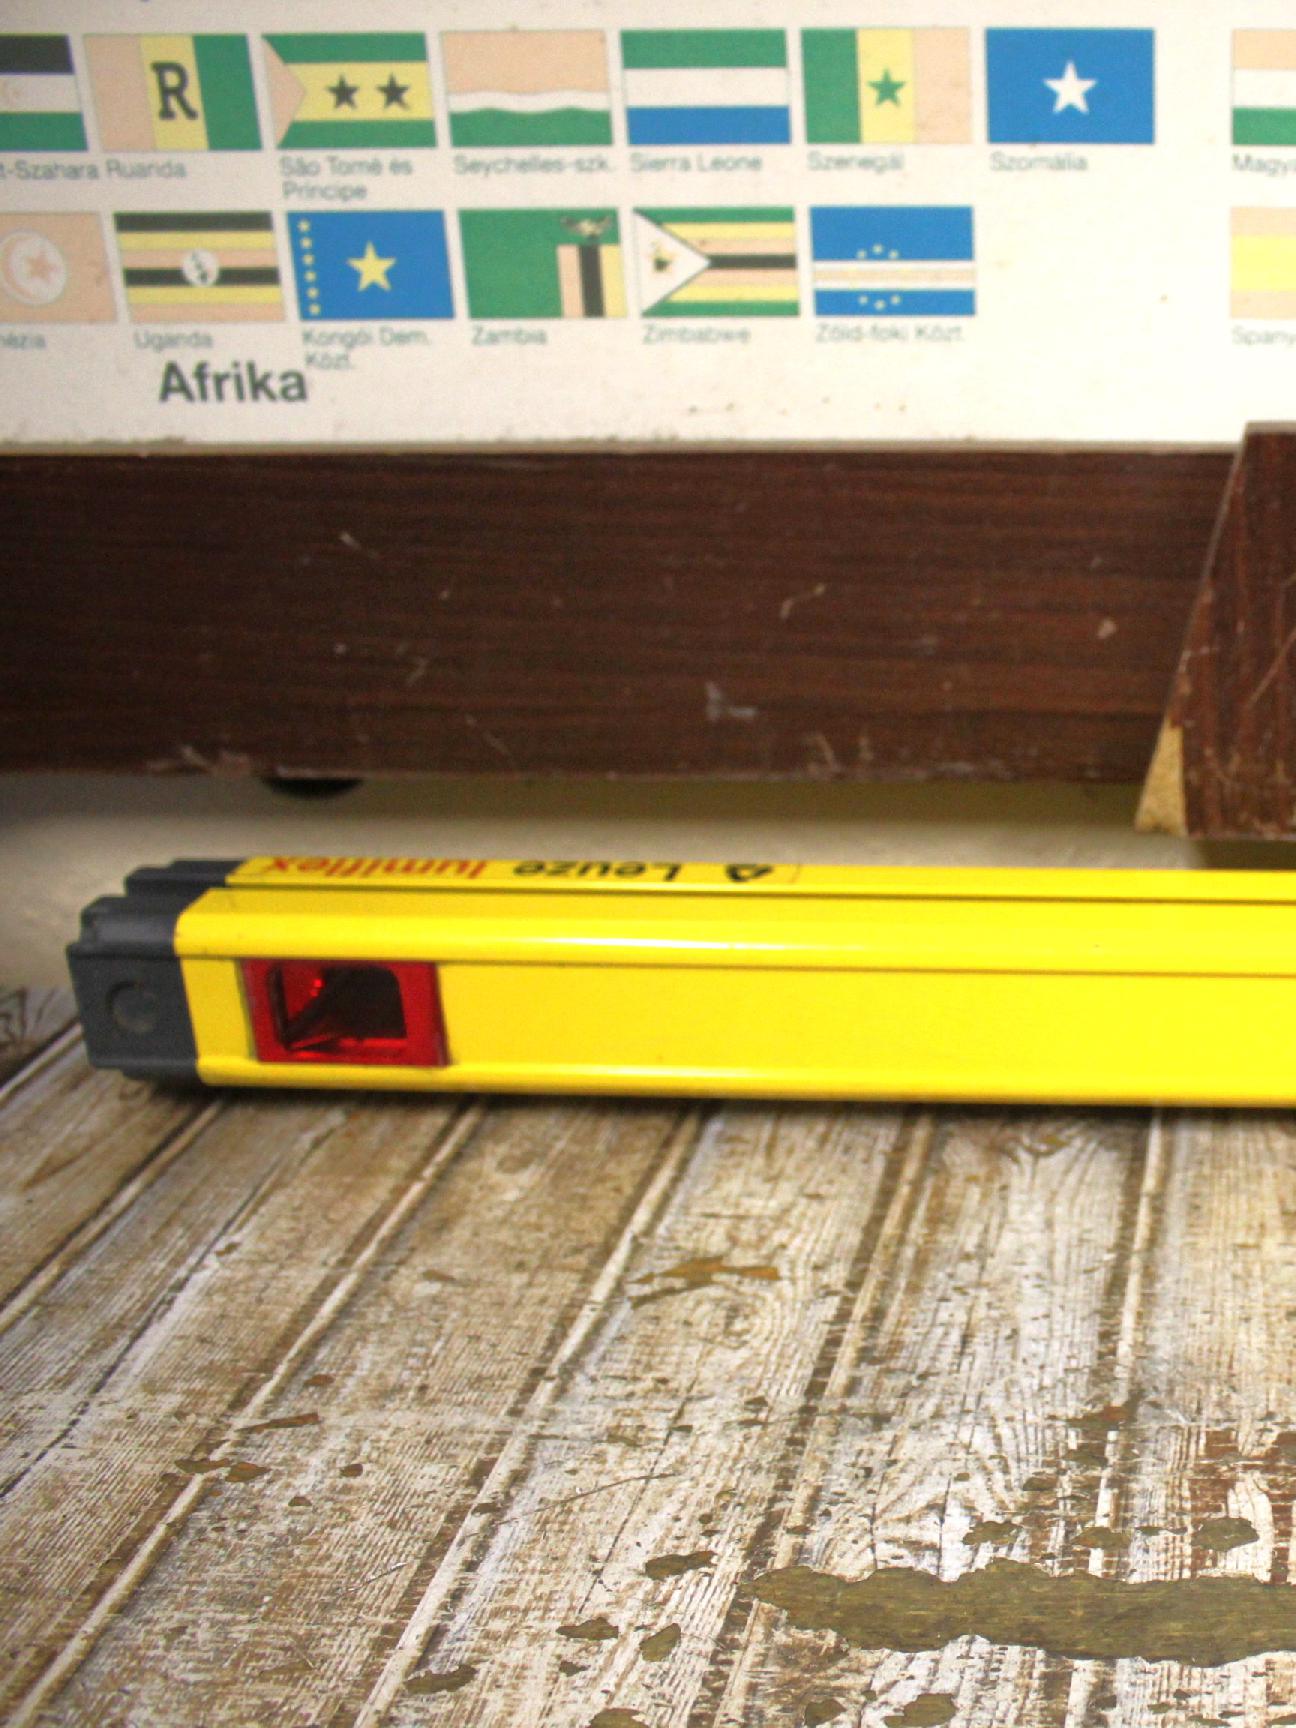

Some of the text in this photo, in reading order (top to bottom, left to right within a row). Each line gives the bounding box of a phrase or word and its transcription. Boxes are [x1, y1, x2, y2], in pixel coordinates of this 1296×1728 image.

[152, 62, 199, 120] R
[105, 158, 187, 179] Ruanda
[630, 153, 763, 173] Sierra Leone
[807, 151, 904, 174] Szenegál
[990, 151, 1088, 173] Szomália
[133, 329, 214, 351] Uganda
[471, 325, 548, 347] Zambia
[642, 323, 752, 345] Zimbabwe
[159, 360, 308, 402] Afrika
[512, 859, 683, 882] Leuze
